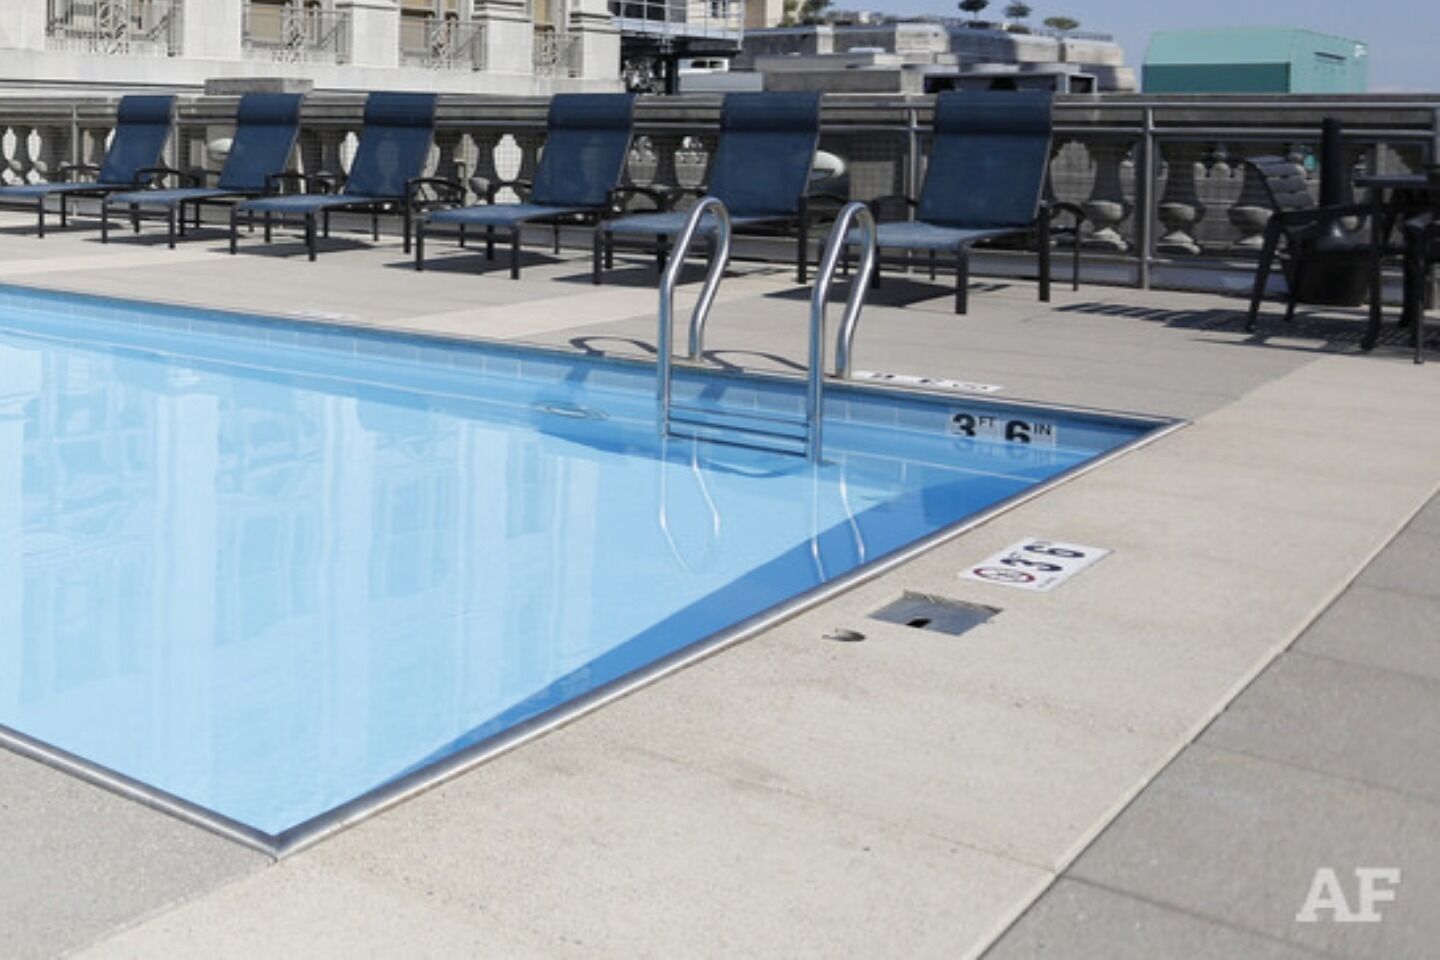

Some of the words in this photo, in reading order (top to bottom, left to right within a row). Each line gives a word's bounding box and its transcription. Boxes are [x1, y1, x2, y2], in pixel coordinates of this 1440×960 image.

[952, 413, 976, 437] 3
[978, 416, 996, 427] FT
[1005, 419, 1030, 444] 6
[1033, 423, 1051, 436] IN
